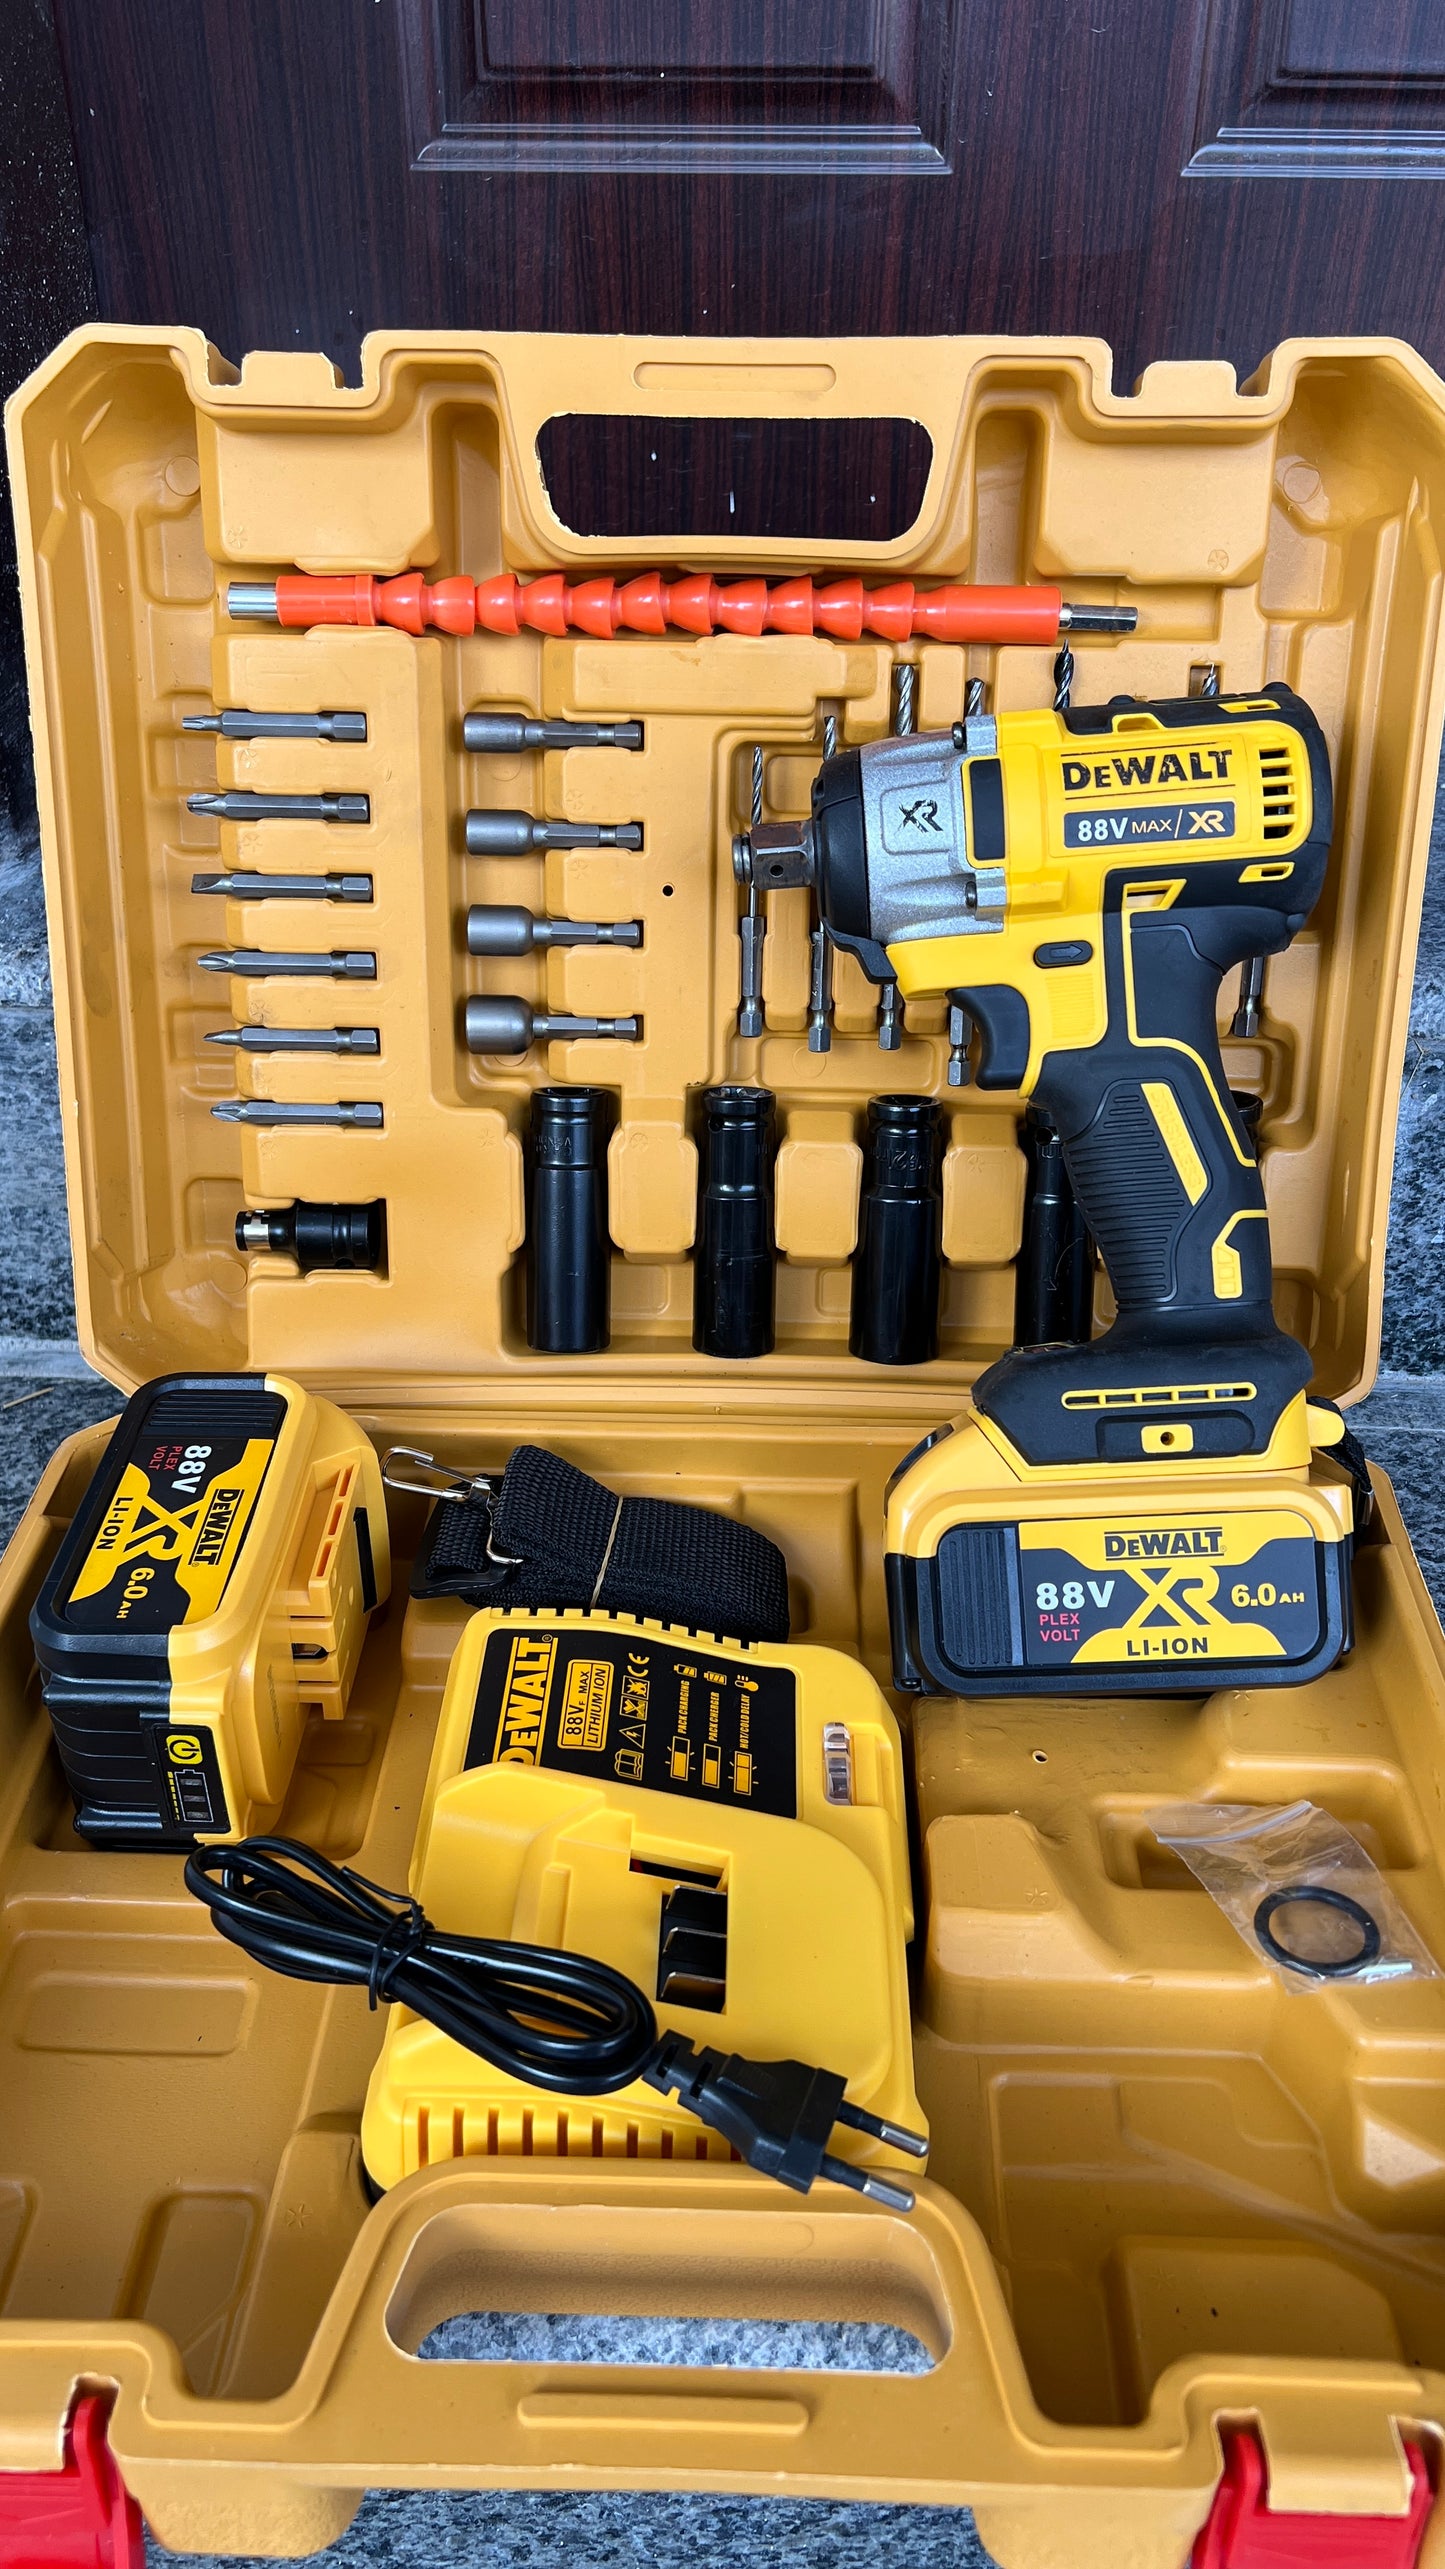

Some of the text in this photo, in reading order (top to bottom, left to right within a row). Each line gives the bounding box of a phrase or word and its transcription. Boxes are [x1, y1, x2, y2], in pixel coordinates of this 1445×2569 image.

[1062, 750, 1232, 791] DEWALT
[897, 800, 943, 833] XR
[1078, 817, 1128, 842] 88V
[148, 1446, 168, 1470] VOLT
[165, 1446, 183, 1470] PLEX
[171, 1445, 212, 1493] 88V
[96, 1497, 134, 1549] LI-ION
[117, 1495, 204, 1567] XR
[194, 1489, 240, 1565] DEWALT
[1105, 1532, 1223, 1557] DEWALT
[1036, 1580, 1115, 1610] 88V
[1122, 1566, 1232, 1629] XR
[1039, 1613, 1080, 1626] PLEX
[1040, 1629, 1080, 1642] VOLT
[1127, 1637, 1208, 1656] LI-ION
[579, 1671, 590, 1694] MAX
[587, 1668, 606, 1744] LITHIUM ION
[677, 1680, 690, 1734] PACK CHARGING
[740, 1694, 750, 1749] HOT/COLD DELAY
[708, 1723, 718, 1742] PACK
